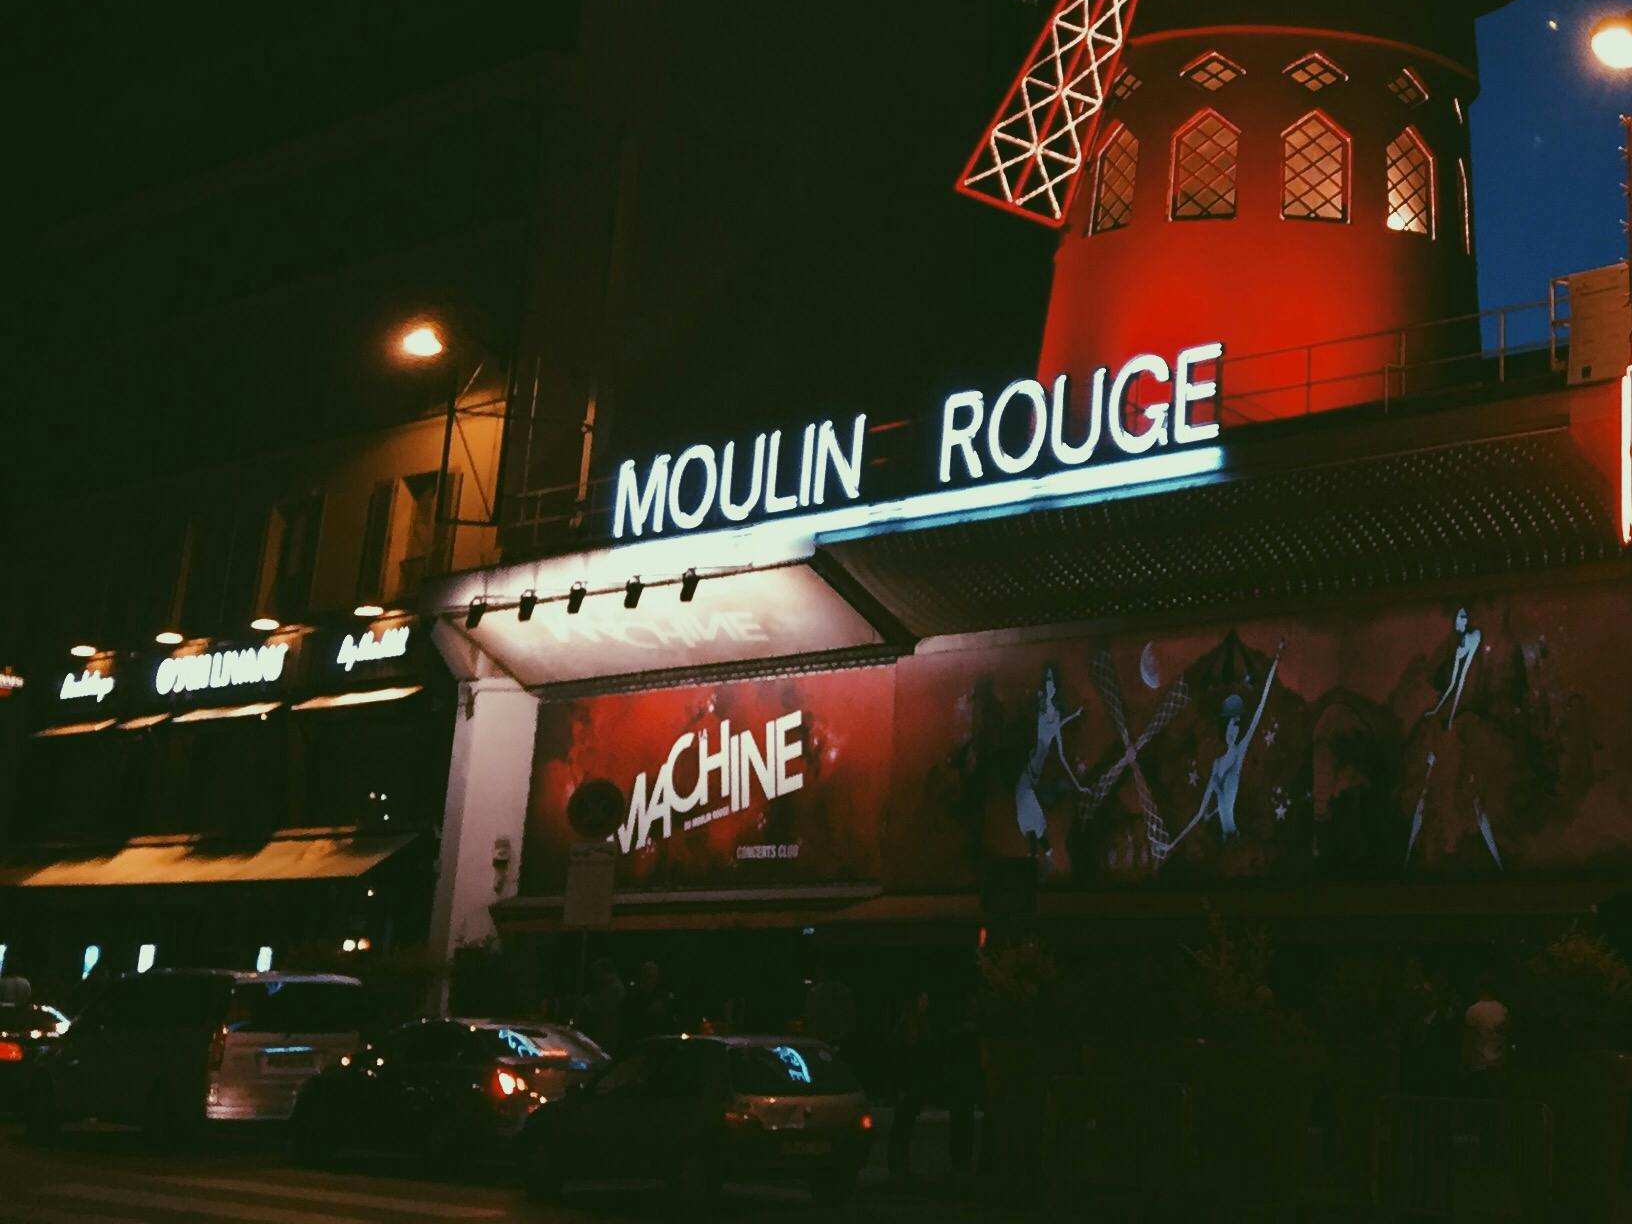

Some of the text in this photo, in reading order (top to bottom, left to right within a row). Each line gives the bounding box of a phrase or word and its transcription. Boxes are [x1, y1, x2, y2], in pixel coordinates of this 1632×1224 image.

[611, 343, 1224, 538] MOULIN ROUGE
[606, 709, 804, 855] MACHINE
